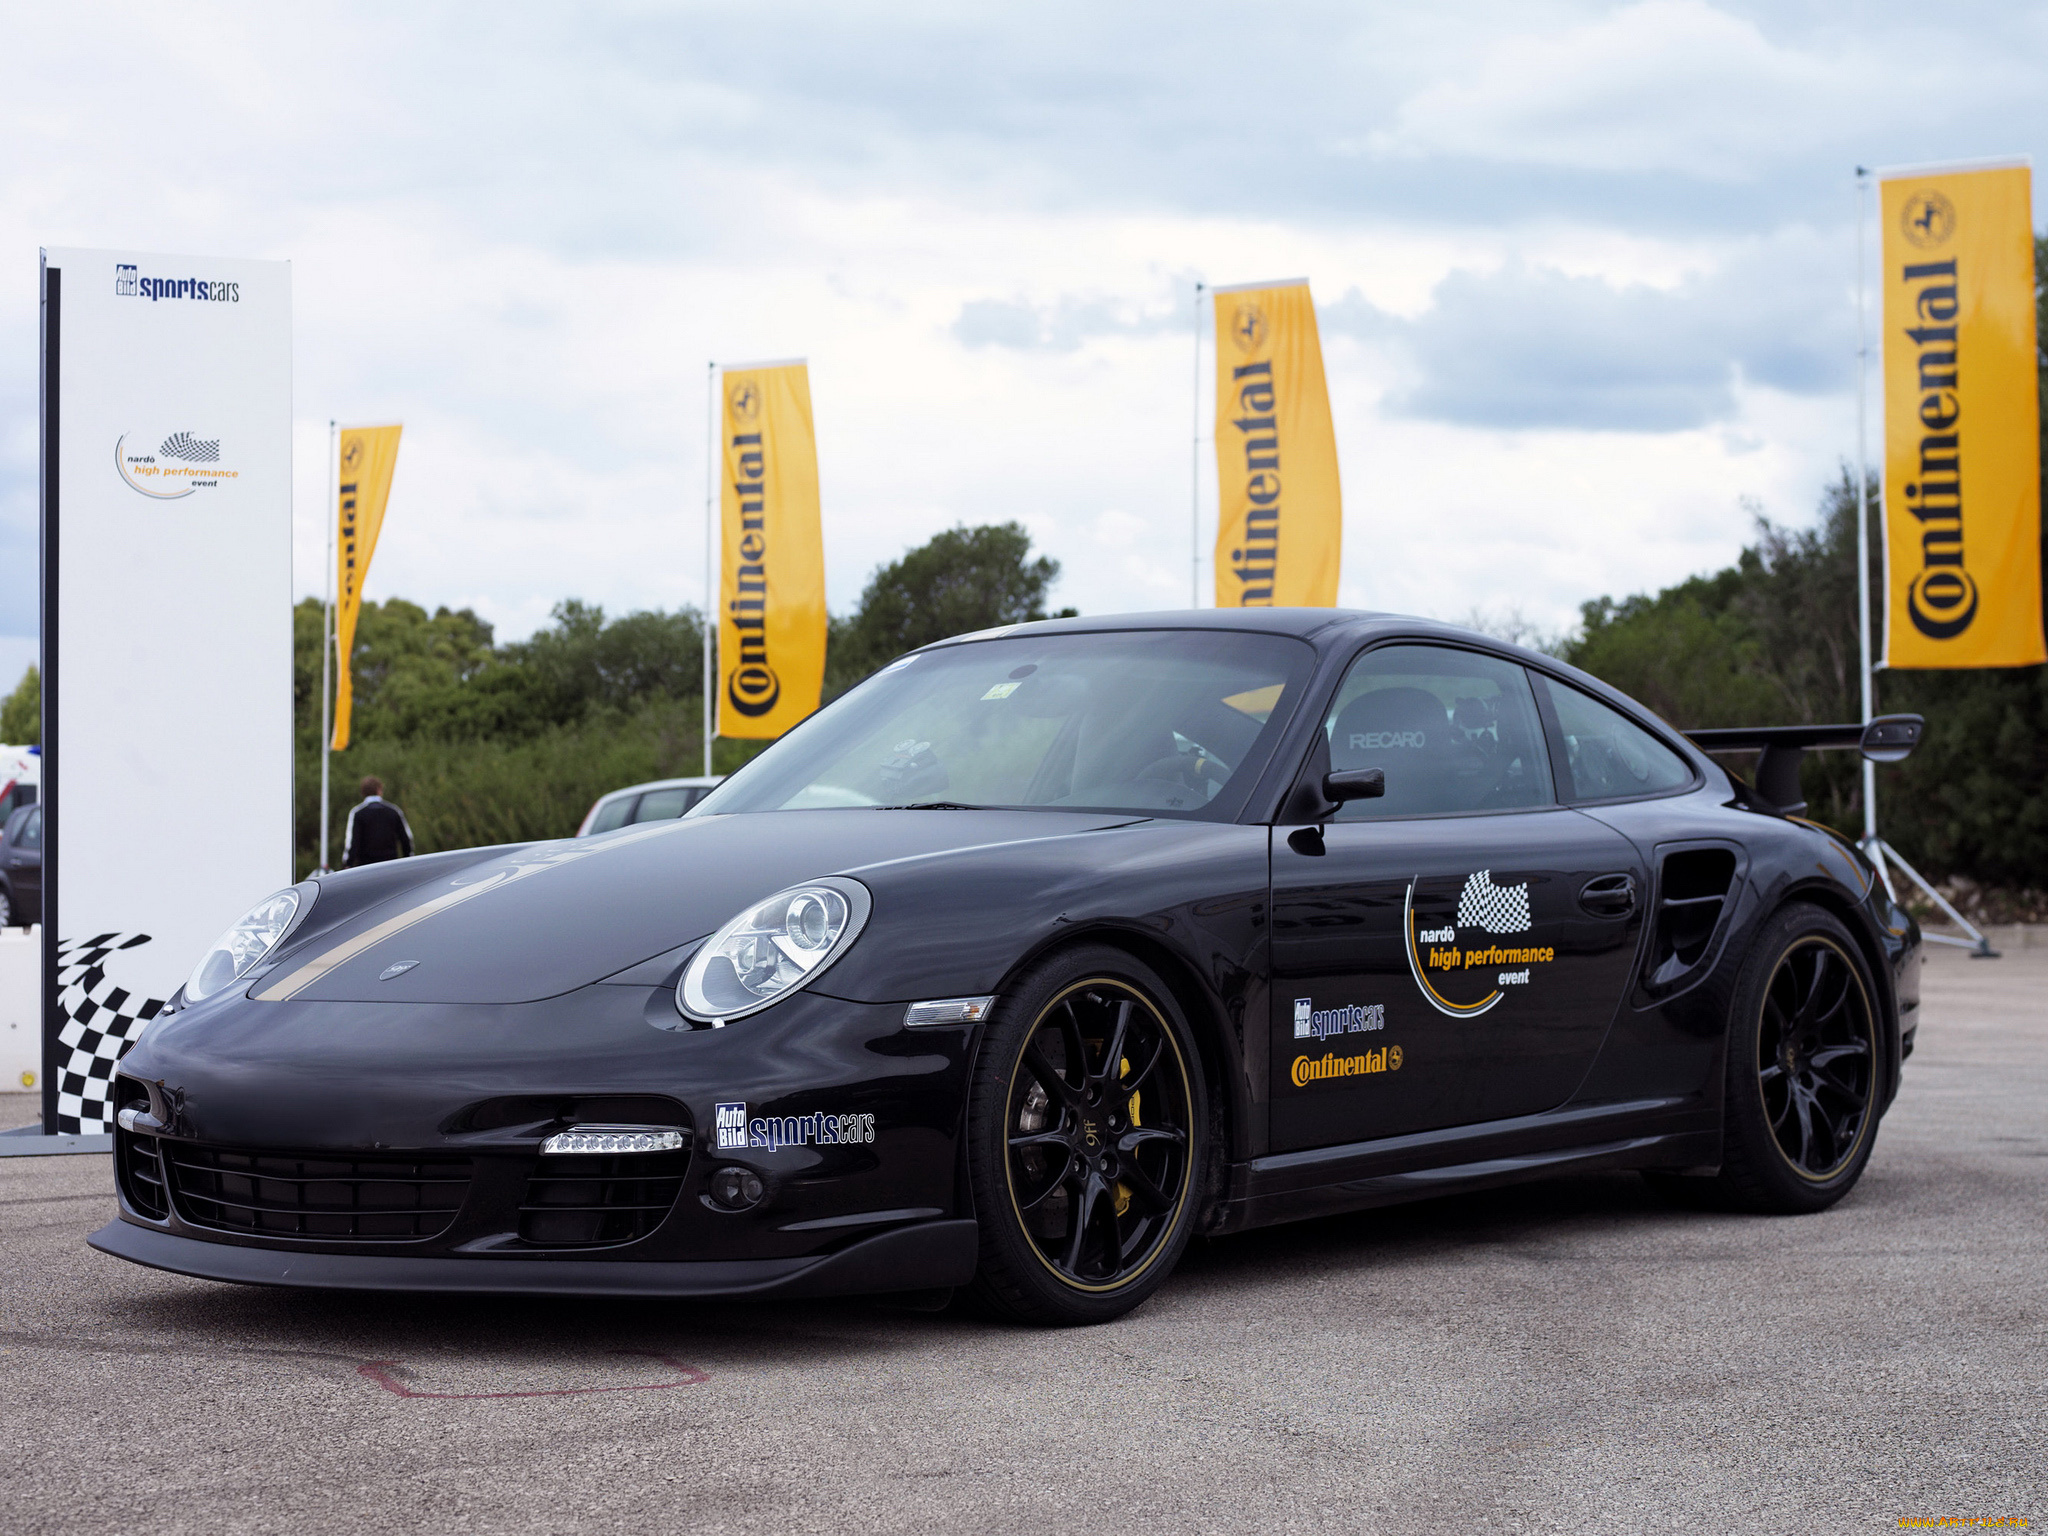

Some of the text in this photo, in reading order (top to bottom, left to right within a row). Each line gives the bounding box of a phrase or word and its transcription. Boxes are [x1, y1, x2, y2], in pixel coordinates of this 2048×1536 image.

[140, 277, 240, 302] sportscars
[1903, 256, 1979, 641] Continental
[133, 465, 239, 479] high performance
[1231, 358, 1281, 608] ntinental
[728, 431, 780, 717] Continental
[1350, 730, 1425, 750] RECARO
[1420, 926, 1456, 943] nardò
[1429, 945, 1554, 971] high performance
[1498, 968, 1531, 985] event
[1294, 1001, 1311, 1020] Auto
[1311, 1003, 1385, 1041] sportscars
[1294, 1020, 1310, 1037] Bild
[1291, 1047, 1388, 1087] Continental
[716, 1106, 746, 1128] Auto
[718, 1127, 747, 1147] Bild
[749, 1111, 875, 1153] sportscars
